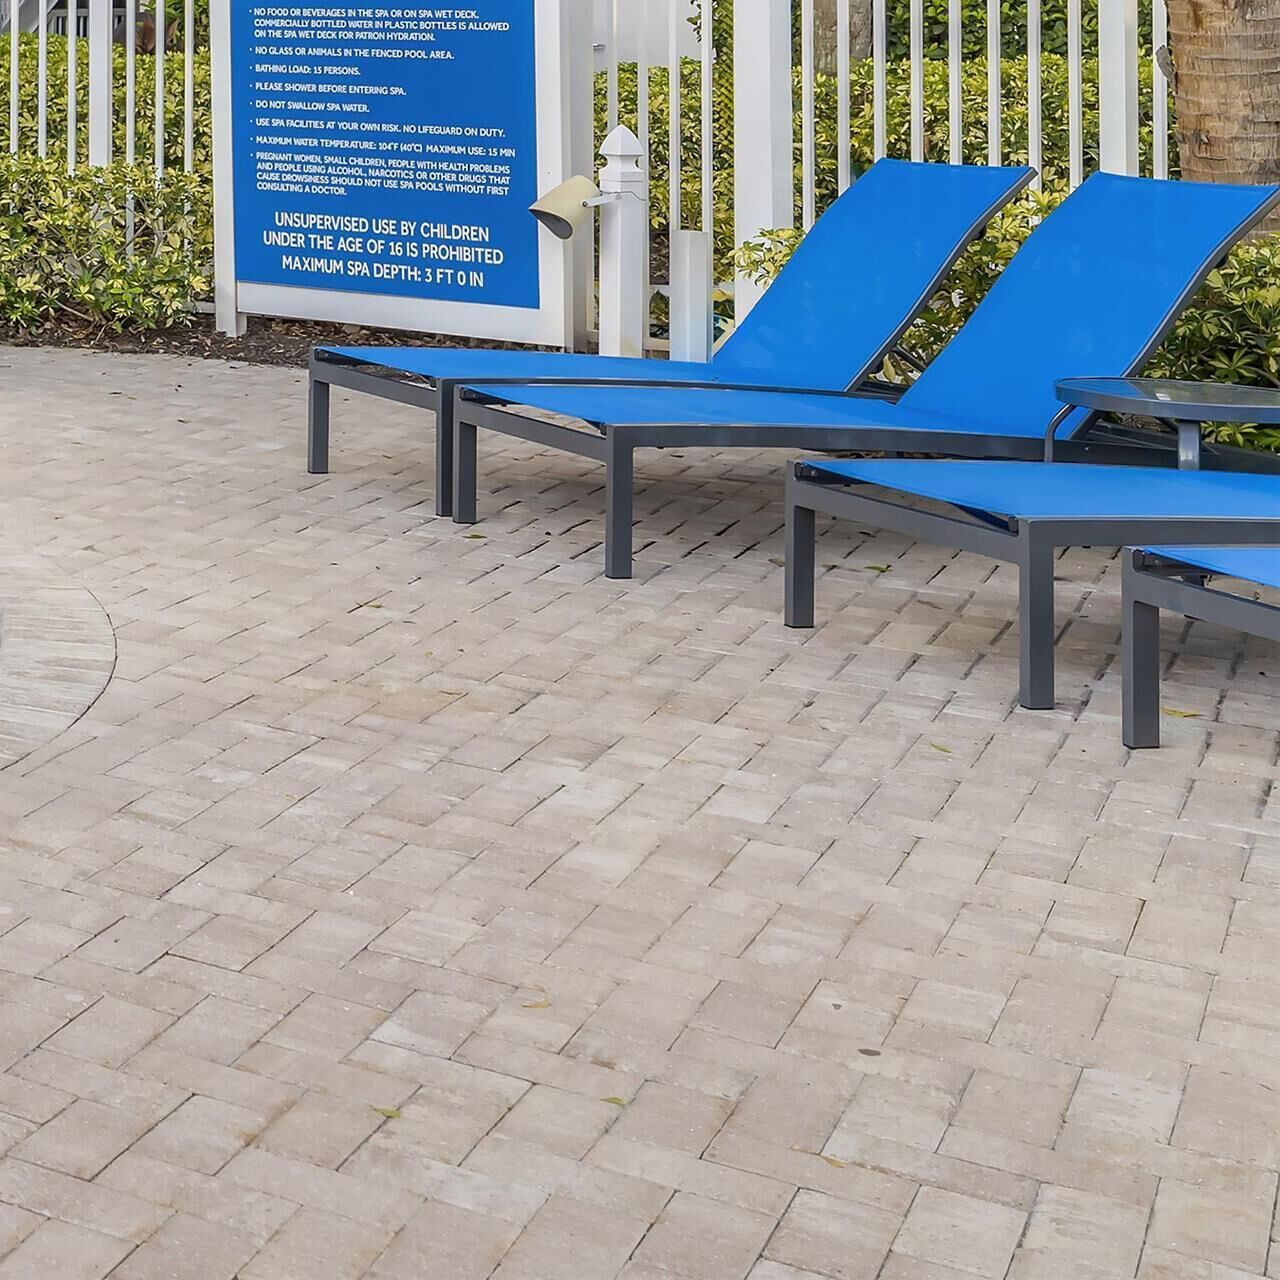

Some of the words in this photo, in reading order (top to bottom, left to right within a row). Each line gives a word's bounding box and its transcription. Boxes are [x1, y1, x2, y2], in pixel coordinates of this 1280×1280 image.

[254, 8, 266, 16] NO
[267, 8, 289, 16] FOOD
[290, 8, 301, 16] OR
[302, 8, 346, 17] BEVERAGES
[347, 9, 356, 17] IN
[358, 9, 373, 17] THE
[375, 9, 389, 18] SPA
[390, 9, 402, 18] OR
[403, 10, 417, 18] ON
[418, 10, 433, 18] SPA
[434, 10, 453, 18] WET
[455, 10, 479, 19] DECK.
[254, 19, 310, 27] COMMERCIALLY
[311, 19, 347, 28] BOTTLED
[348, 20, 373, 29] WATER
[375, 21, 383, 29] IN
[384, 21, 418, 29] PLASTIC
[419, 21, 457, 30] BOTTLES
[458, 22, 466, 30] IS
[468, 22, 510, 31] ALLOWED
[254, 29, 266, 38] ON
[268, 29, 283, 38] THE
[284, 30, 297, 38] SPA
[298, 30, 315, 39] WET
[316, 30, 337, 39] DECK
[338, 31, 354, 39] FOR
[355, 31, 385, 40] PATRON
[386, 32, 435, 41] HYDRATION.
[255, 46, 268, 55] NO
[268, 46, 293, 55] GLASS
[294, 47, 306, 56] OR
[307, 48, 342, 56] ANIMALS
[343, 48, 352, 57] IN
[354, 49, 370, 57] THE
[371, 49, 403, 58] FENCED
[404, 50, 428, 59] POOL
[429, 50, 454, 59] AREA.
[255, 64, 287, 73] BATHING
[288, 65, 311, 74] LOAD:
[314, 66, 322, 74] 15
[323, 66, 360, 75] PERSONS.
[255, 82, 283, 91] PLEASE
[284, 83, 317, 92] SHOWER
[318, 84, 347, 93] BEFORE
[349, 85, 388, 95] ENTERING
[390, 87, 406, 95] SPA.
[255, 100, 268, 108] DO
[269, 100, 286, 109] NOT
[287, 101, 325, 111] SWALLOW
[326, 103, 341, 111] SPA
[342, 103, 369, 113] WATER.
[256, 118, 270, 127] USE
[271, 118, 285, 127] SPA
[286, 119, 325, 129] FACILITIES
[326, 121, 335, 129] AT
[337, 121, 359, 130] YOUR
[360, 123, 380, 131] OWN
[381, 123, 401, 132] RISK.
[403, 124, 416, 133] NO
[418, 125, 463, 135] LIFEGUARD
[464, 127, 478, 136] ON
[479, 128, 505, 137] DUTY.
[256, 136, 292, 145] MAXIMUM
[293, 137, 318, 147] WATER
[320, 139, 376, 150] TEMPERATURE:
[426, 144, 466, 154] MAXIMUM
[467, 146, 486, 156] USE:
[488, 148, 498, 157] 15
[499, 148, 515, 157] MIN
[256, 152, 292, 161] PREGNANT
[293, 154, 322, 163] WOMEN,
[324, 156, 347, 165] SMALL
[348, 157, 387, 167] CHILDREN,
[388, 159, 415, 169] PEOPLE
[416, 160, 437, 170] WITH
[438, 162, 468, 172] HEALTH
[469, 163, 510, 174] PROBLEMS
[257, 161, 273, 171] AND
[274, 162, 302, 173] PEOPLE
[303, 164, 326, 174] USING
[327, 166, 367, 176] ALCOHOL,
[368, 168, 414, 179] NARCOTICS
[416, 171, 428, 180] OR
[429, 172, 457, 182] OTHER
[458, 173, 487, 184] DRUGS
[488, 175, 510, 185] THAT
[256, 171, 280, 181] CAUSE
[281, 173, 329, 184] DROWSINESS
[331, 176, 363, 186] SHOULD
[364, 178, 382, 187] NOT
[383, 179, 398, 189] USE
[400, 180, 414, 190] SPA
[415, 181, 444, 192] POOLS
[445, 183, 485, 194] WITHOUT
[486, 186, 509, 196] FIRST
[256, 181, 303, 193] CONSULTING
[304, 185, 310, 193] A
[311, 185, 347, 195] DOCTOR.
[275, 211, 369, 233] UNSUPERVISED
[372, 218, 397, 235] USE
[400, 220, 416, 237] BY
[420, 222, 489, 242] CHILDREN
[263, 230, 305, 248] UNDER
[308, 234, 334, 251] THE
[337, 236, 363, 253] AGE
[367, 238, 385, 255] OF
[389, 241, 403, 257] 16
[406, 242, 418, 258] IS
[422, 243, 504, 265] PROHIBITED
[282, 255, 344, 275] MAXIMUM
[347, 260, 370, 277] SPA
[373, 263, 421, 282] DEPTH:
[425, 268, 432, 283] 3
[436, 268, 454, 284] FT
[457, 270, 466, 286] 0
[469, 271, 484, 287] IN
